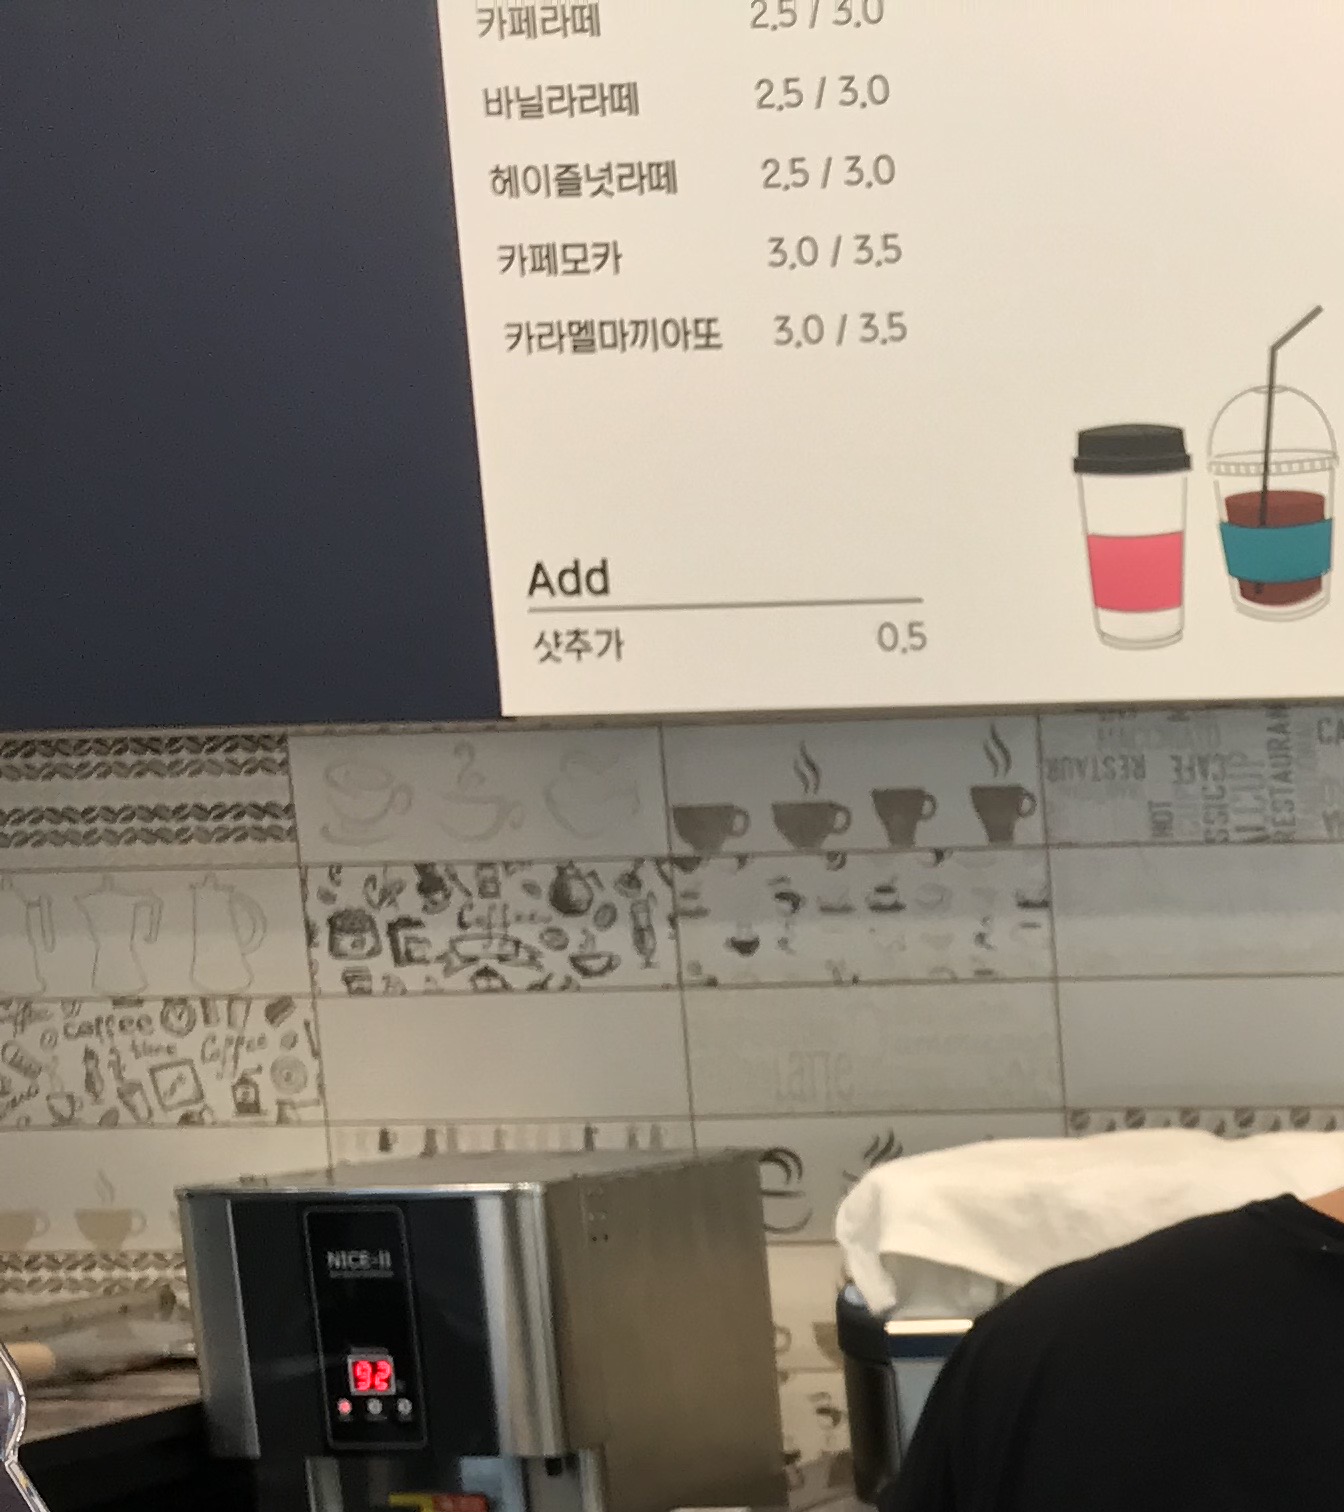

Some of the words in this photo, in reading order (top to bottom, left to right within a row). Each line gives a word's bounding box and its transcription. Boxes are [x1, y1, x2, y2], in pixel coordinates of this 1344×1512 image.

[478, 3, 601, 39] 카페라떼
[484, 82, 639, 119] 바닐라라떼
[755, 77, 803, 111] 2.5
[839, 75, 889, 108] 3.0
[491, 160, 677, 197] 헤이즐넛라떼
[762, 157, 809, 191] 2.5
[845, 154, 895, 188] 3.0
[499, 241, 622, 276] 카페모카
[769, 236, 818, 270] 3.0
[854, 233, 902, 267] 3.5
[507, 318, 722, 353] 카라멜마끼아또
[775, 314, 824, 348] 3.0
[860, 312, 907, 345] 3.5
[529, 559, 609, 596] Add
[535, 629, 623, 662] 샷추가
[877, 621, 927, 654] 0.5
[353, 1360, 392, 1393] 92
